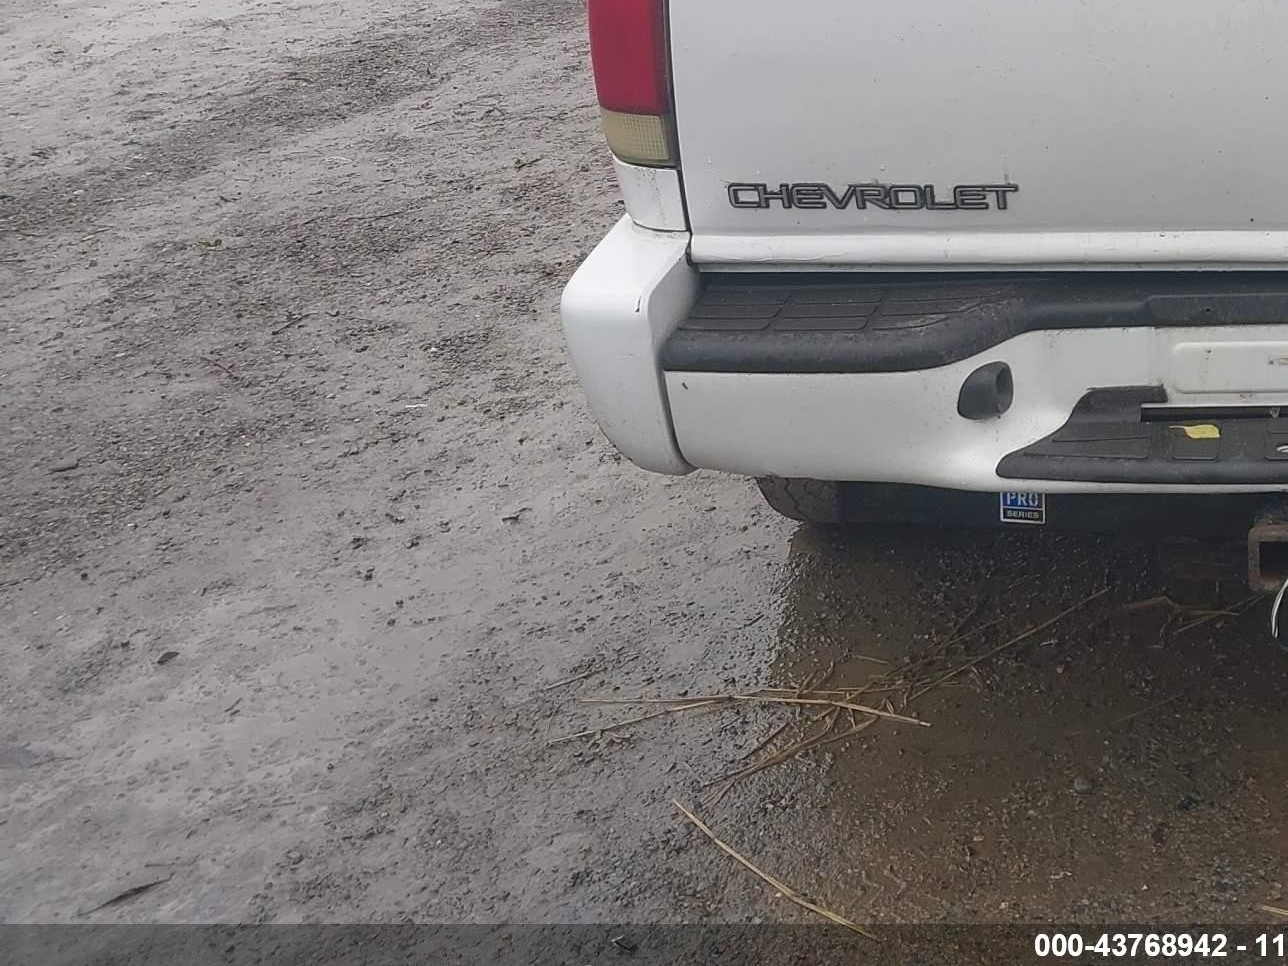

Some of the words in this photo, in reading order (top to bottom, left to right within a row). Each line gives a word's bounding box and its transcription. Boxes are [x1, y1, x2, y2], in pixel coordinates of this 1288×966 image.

[727, 183, 1018, 210] CHEVROLET
[1006, 492, 1039, 506] PRO
[1007, 510, 1040, 518] SERIES
